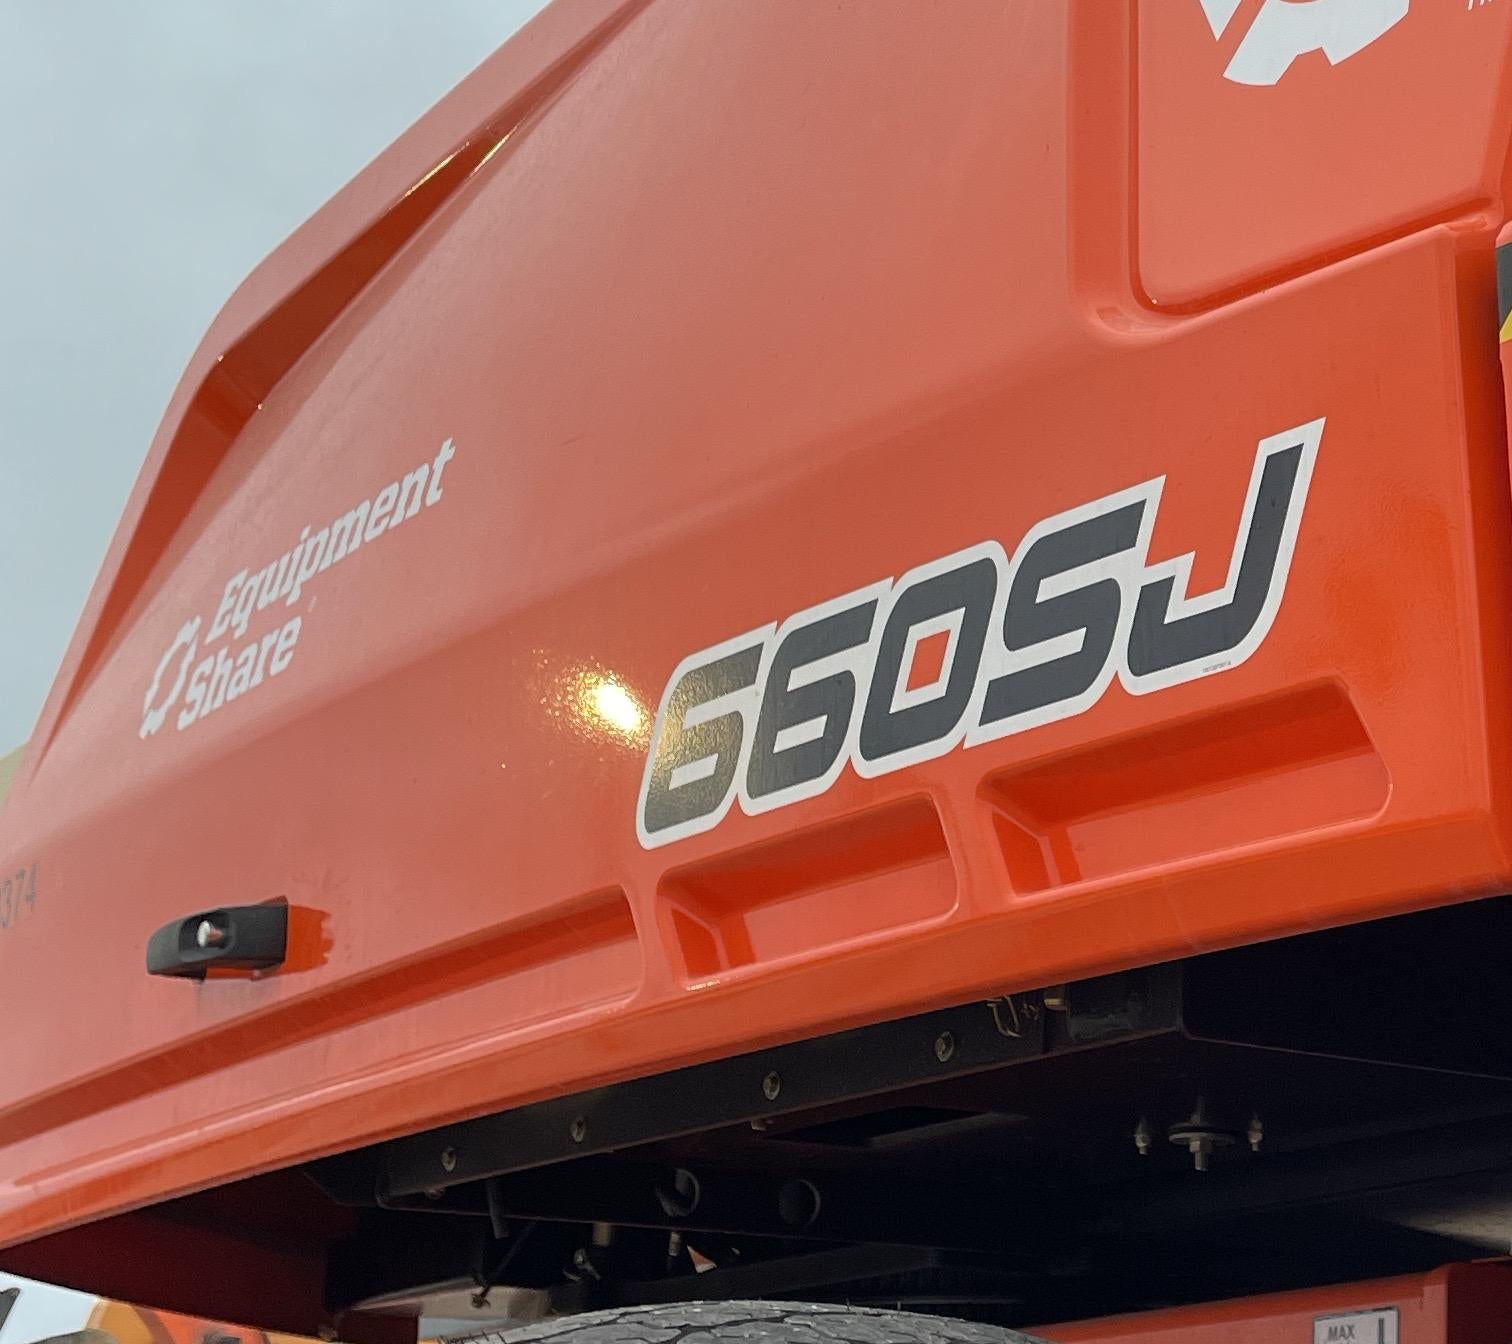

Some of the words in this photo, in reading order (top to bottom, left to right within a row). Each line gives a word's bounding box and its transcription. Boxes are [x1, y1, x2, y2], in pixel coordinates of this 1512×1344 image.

[206, 437, 456, 648] Equipment
[177, 615, 302, 732] Share
[636, 417, 1325, 850] 660SJ
[1327, 1323, 1356, 1342] MAX
